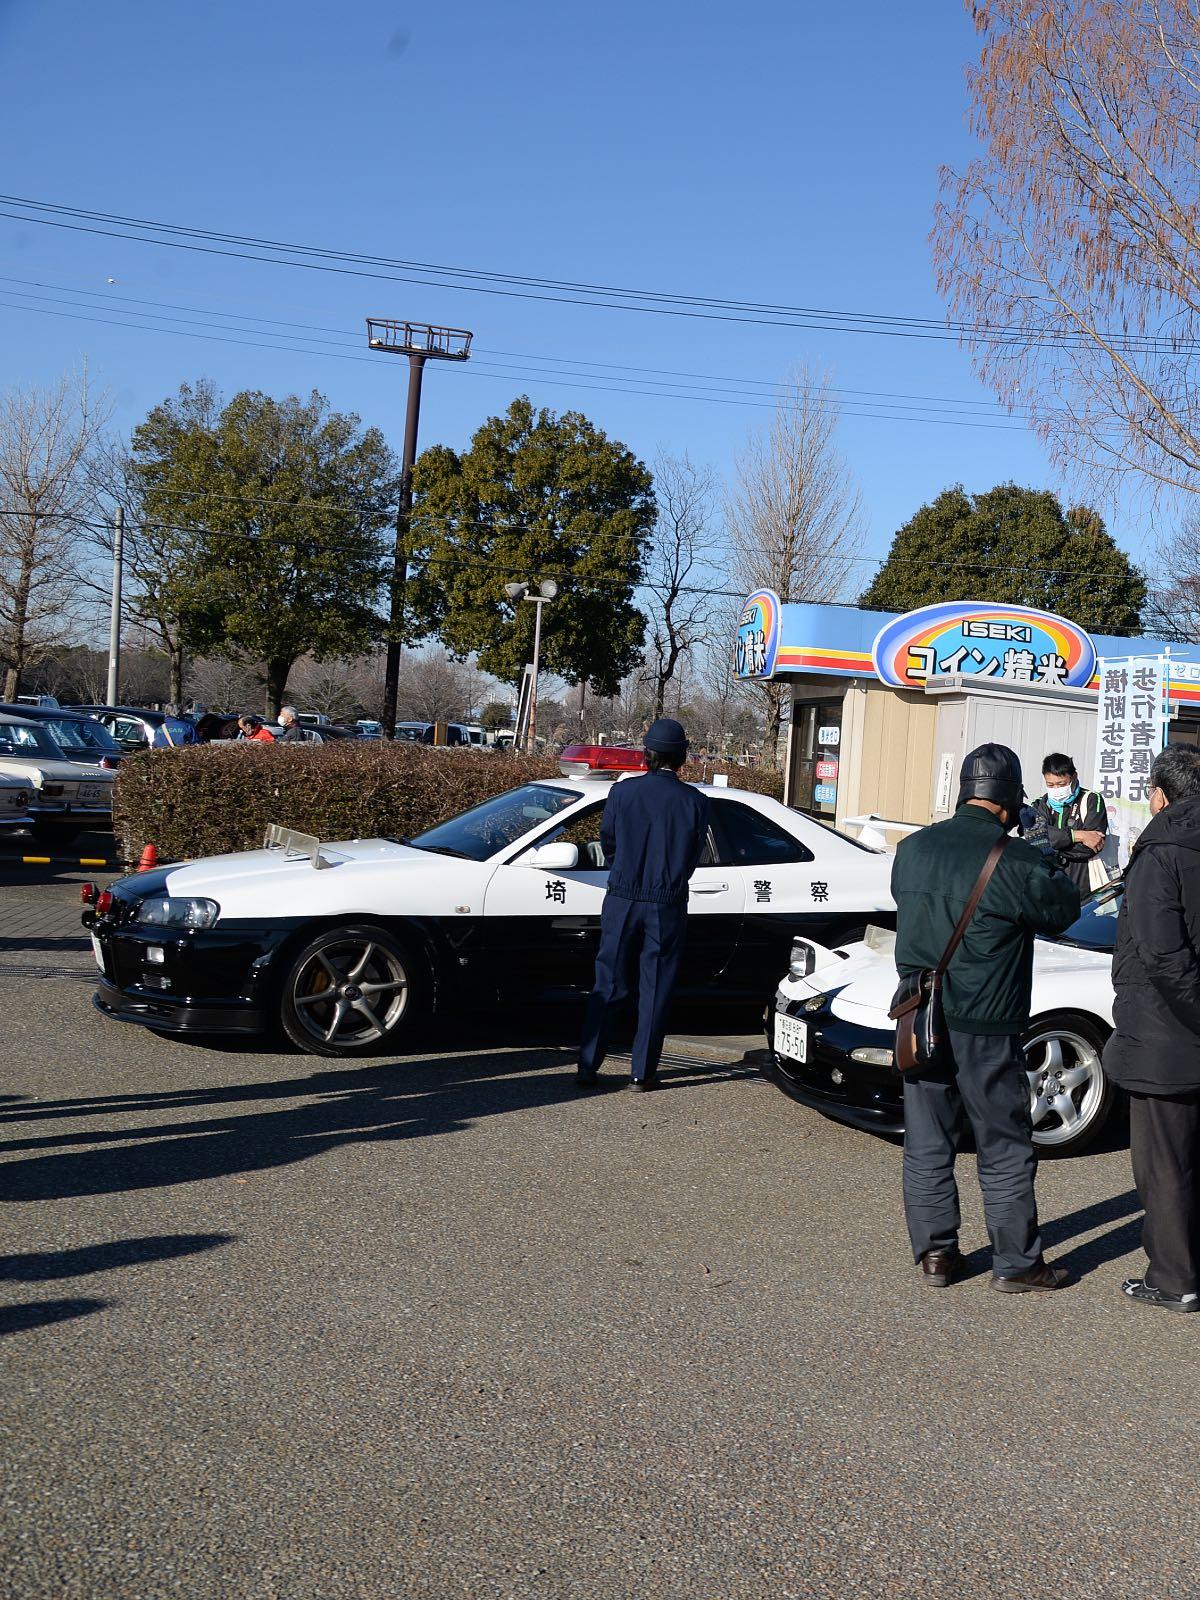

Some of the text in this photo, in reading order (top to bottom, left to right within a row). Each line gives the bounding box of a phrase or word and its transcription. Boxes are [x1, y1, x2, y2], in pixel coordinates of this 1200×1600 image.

[962, 621, 1032, 643] ISEKI
[906, 645, 1069, 687] コイン精米
[781, 1031, 805, 1059] 75-50
